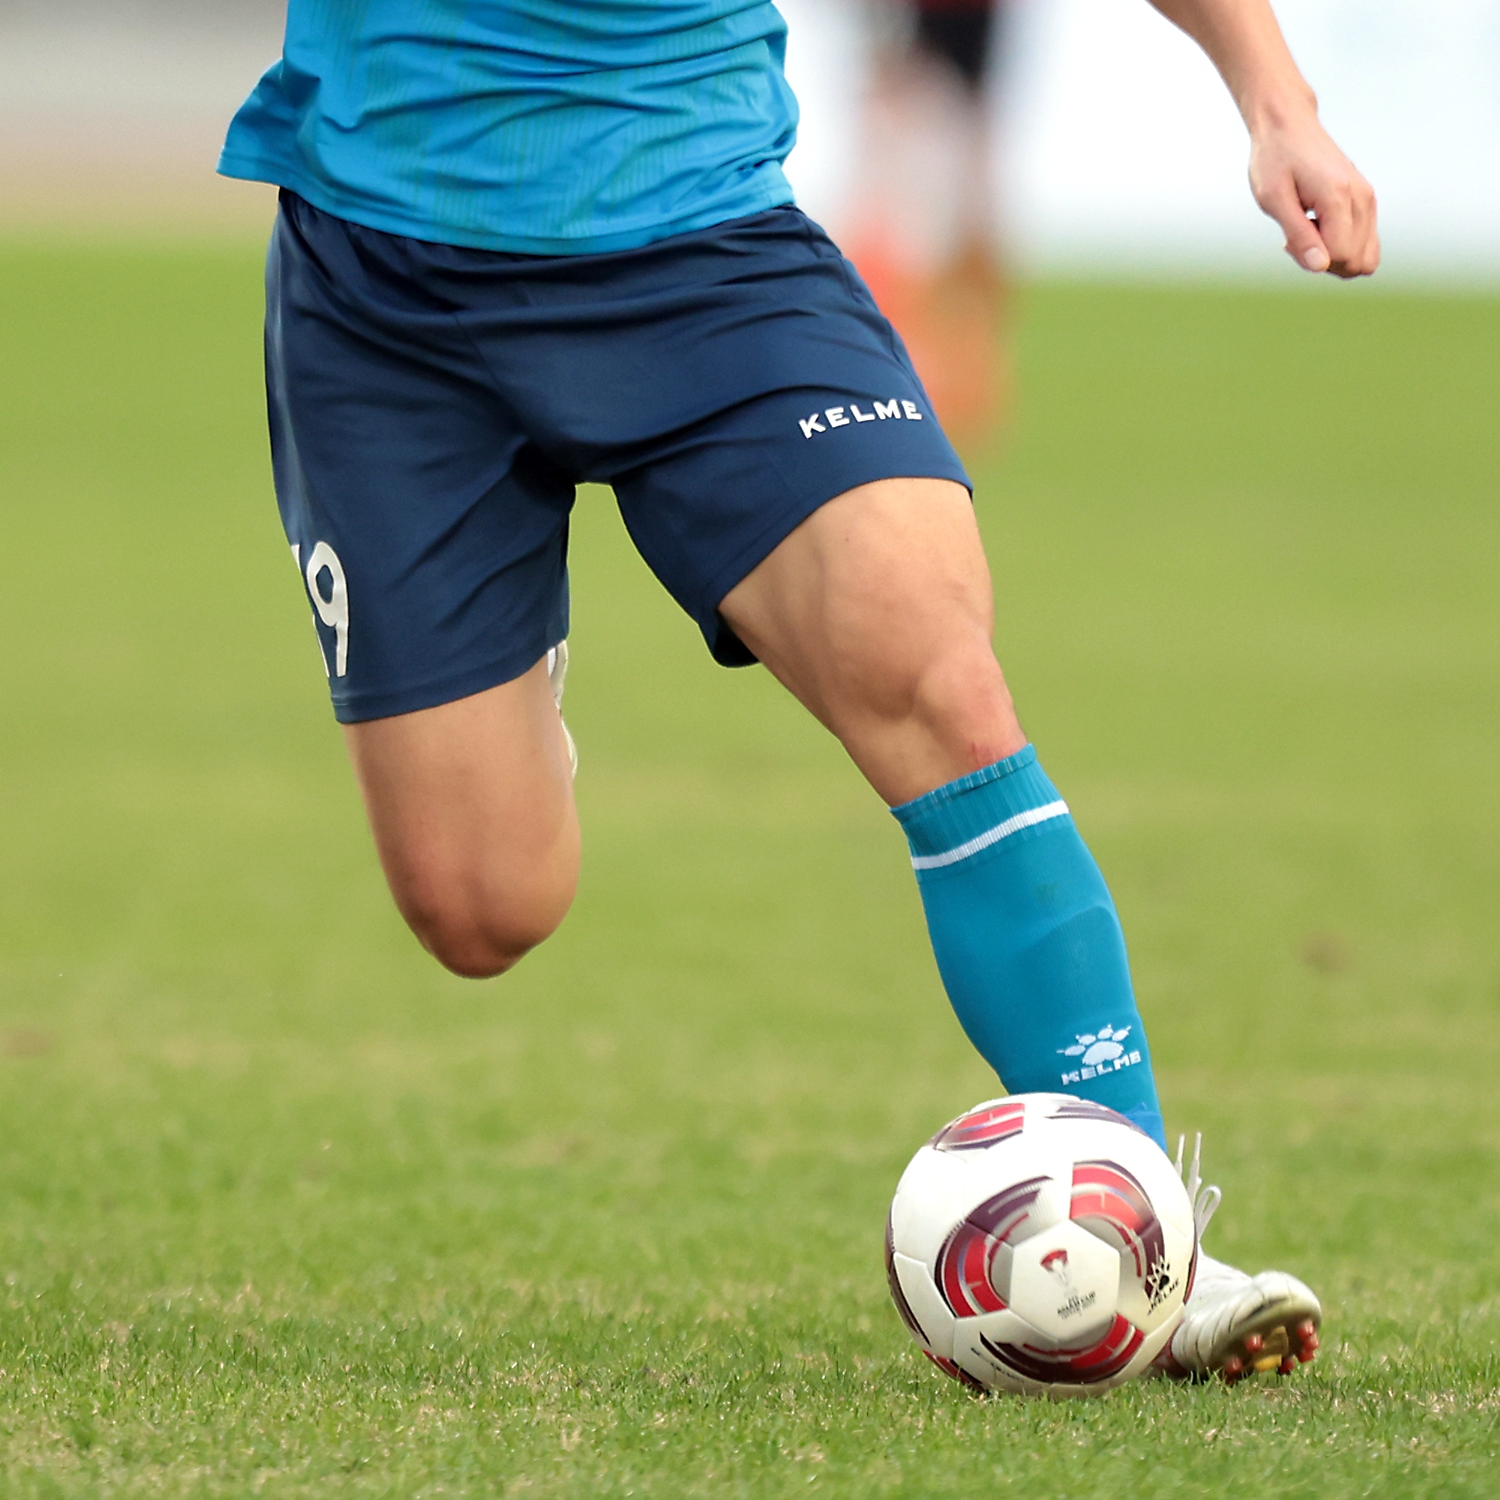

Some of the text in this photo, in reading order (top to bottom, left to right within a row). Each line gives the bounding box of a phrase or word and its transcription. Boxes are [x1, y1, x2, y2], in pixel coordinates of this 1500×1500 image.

[798, 398, 923, 439] KELME
[290, 540, 349, 678] 9
[1061, 1050, 1142, 1086] KELME
